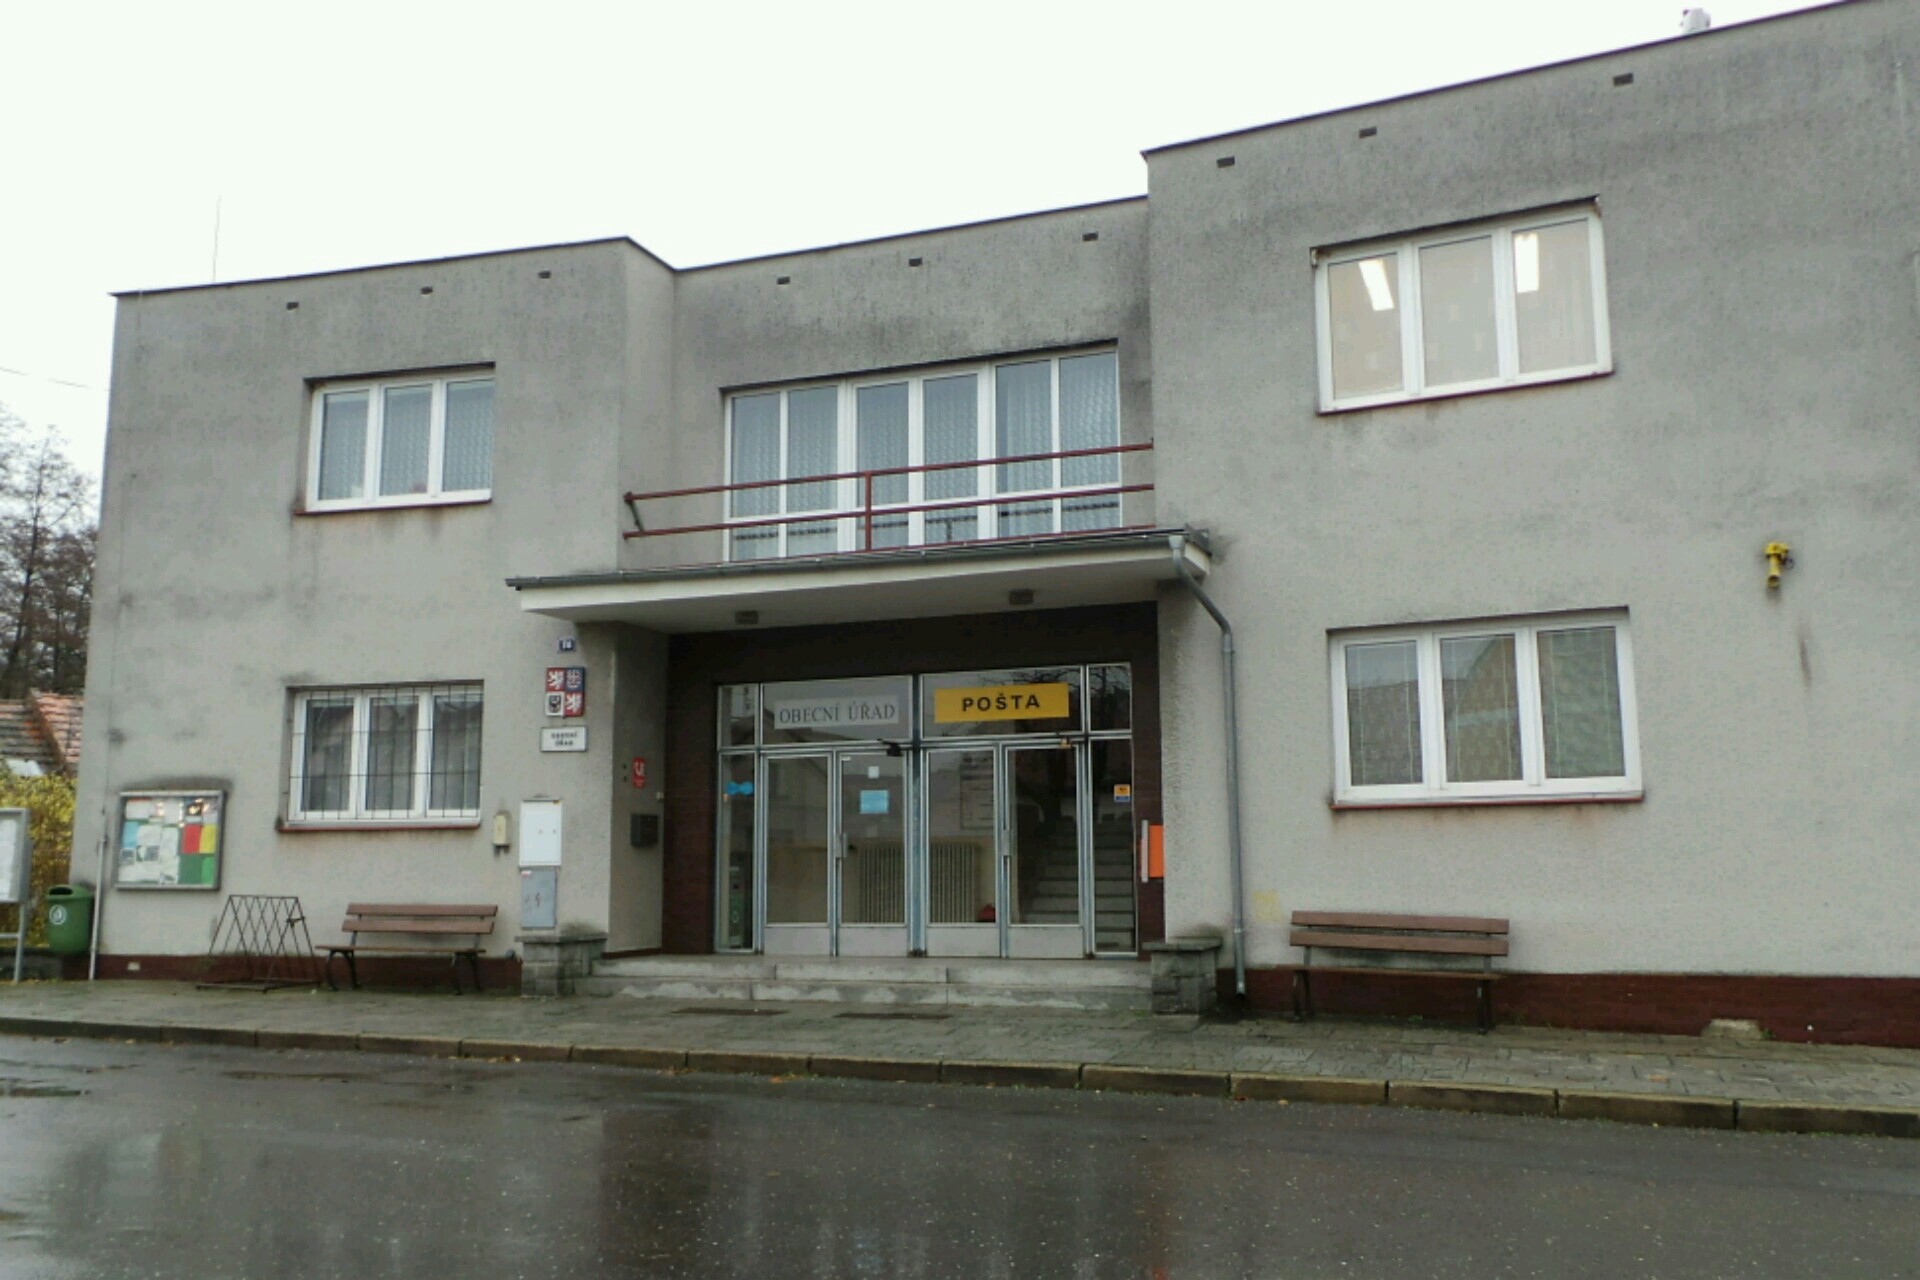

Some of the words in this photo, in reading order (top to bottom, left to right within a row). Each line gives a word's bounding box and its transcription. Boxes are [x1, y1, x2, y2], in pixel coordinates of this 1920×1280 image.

[780, 702, 840, 724] OBECNÍ
[848, 700, 896, 721] ÚŘAD
[962, 692, 1040, 712] POŠTA
